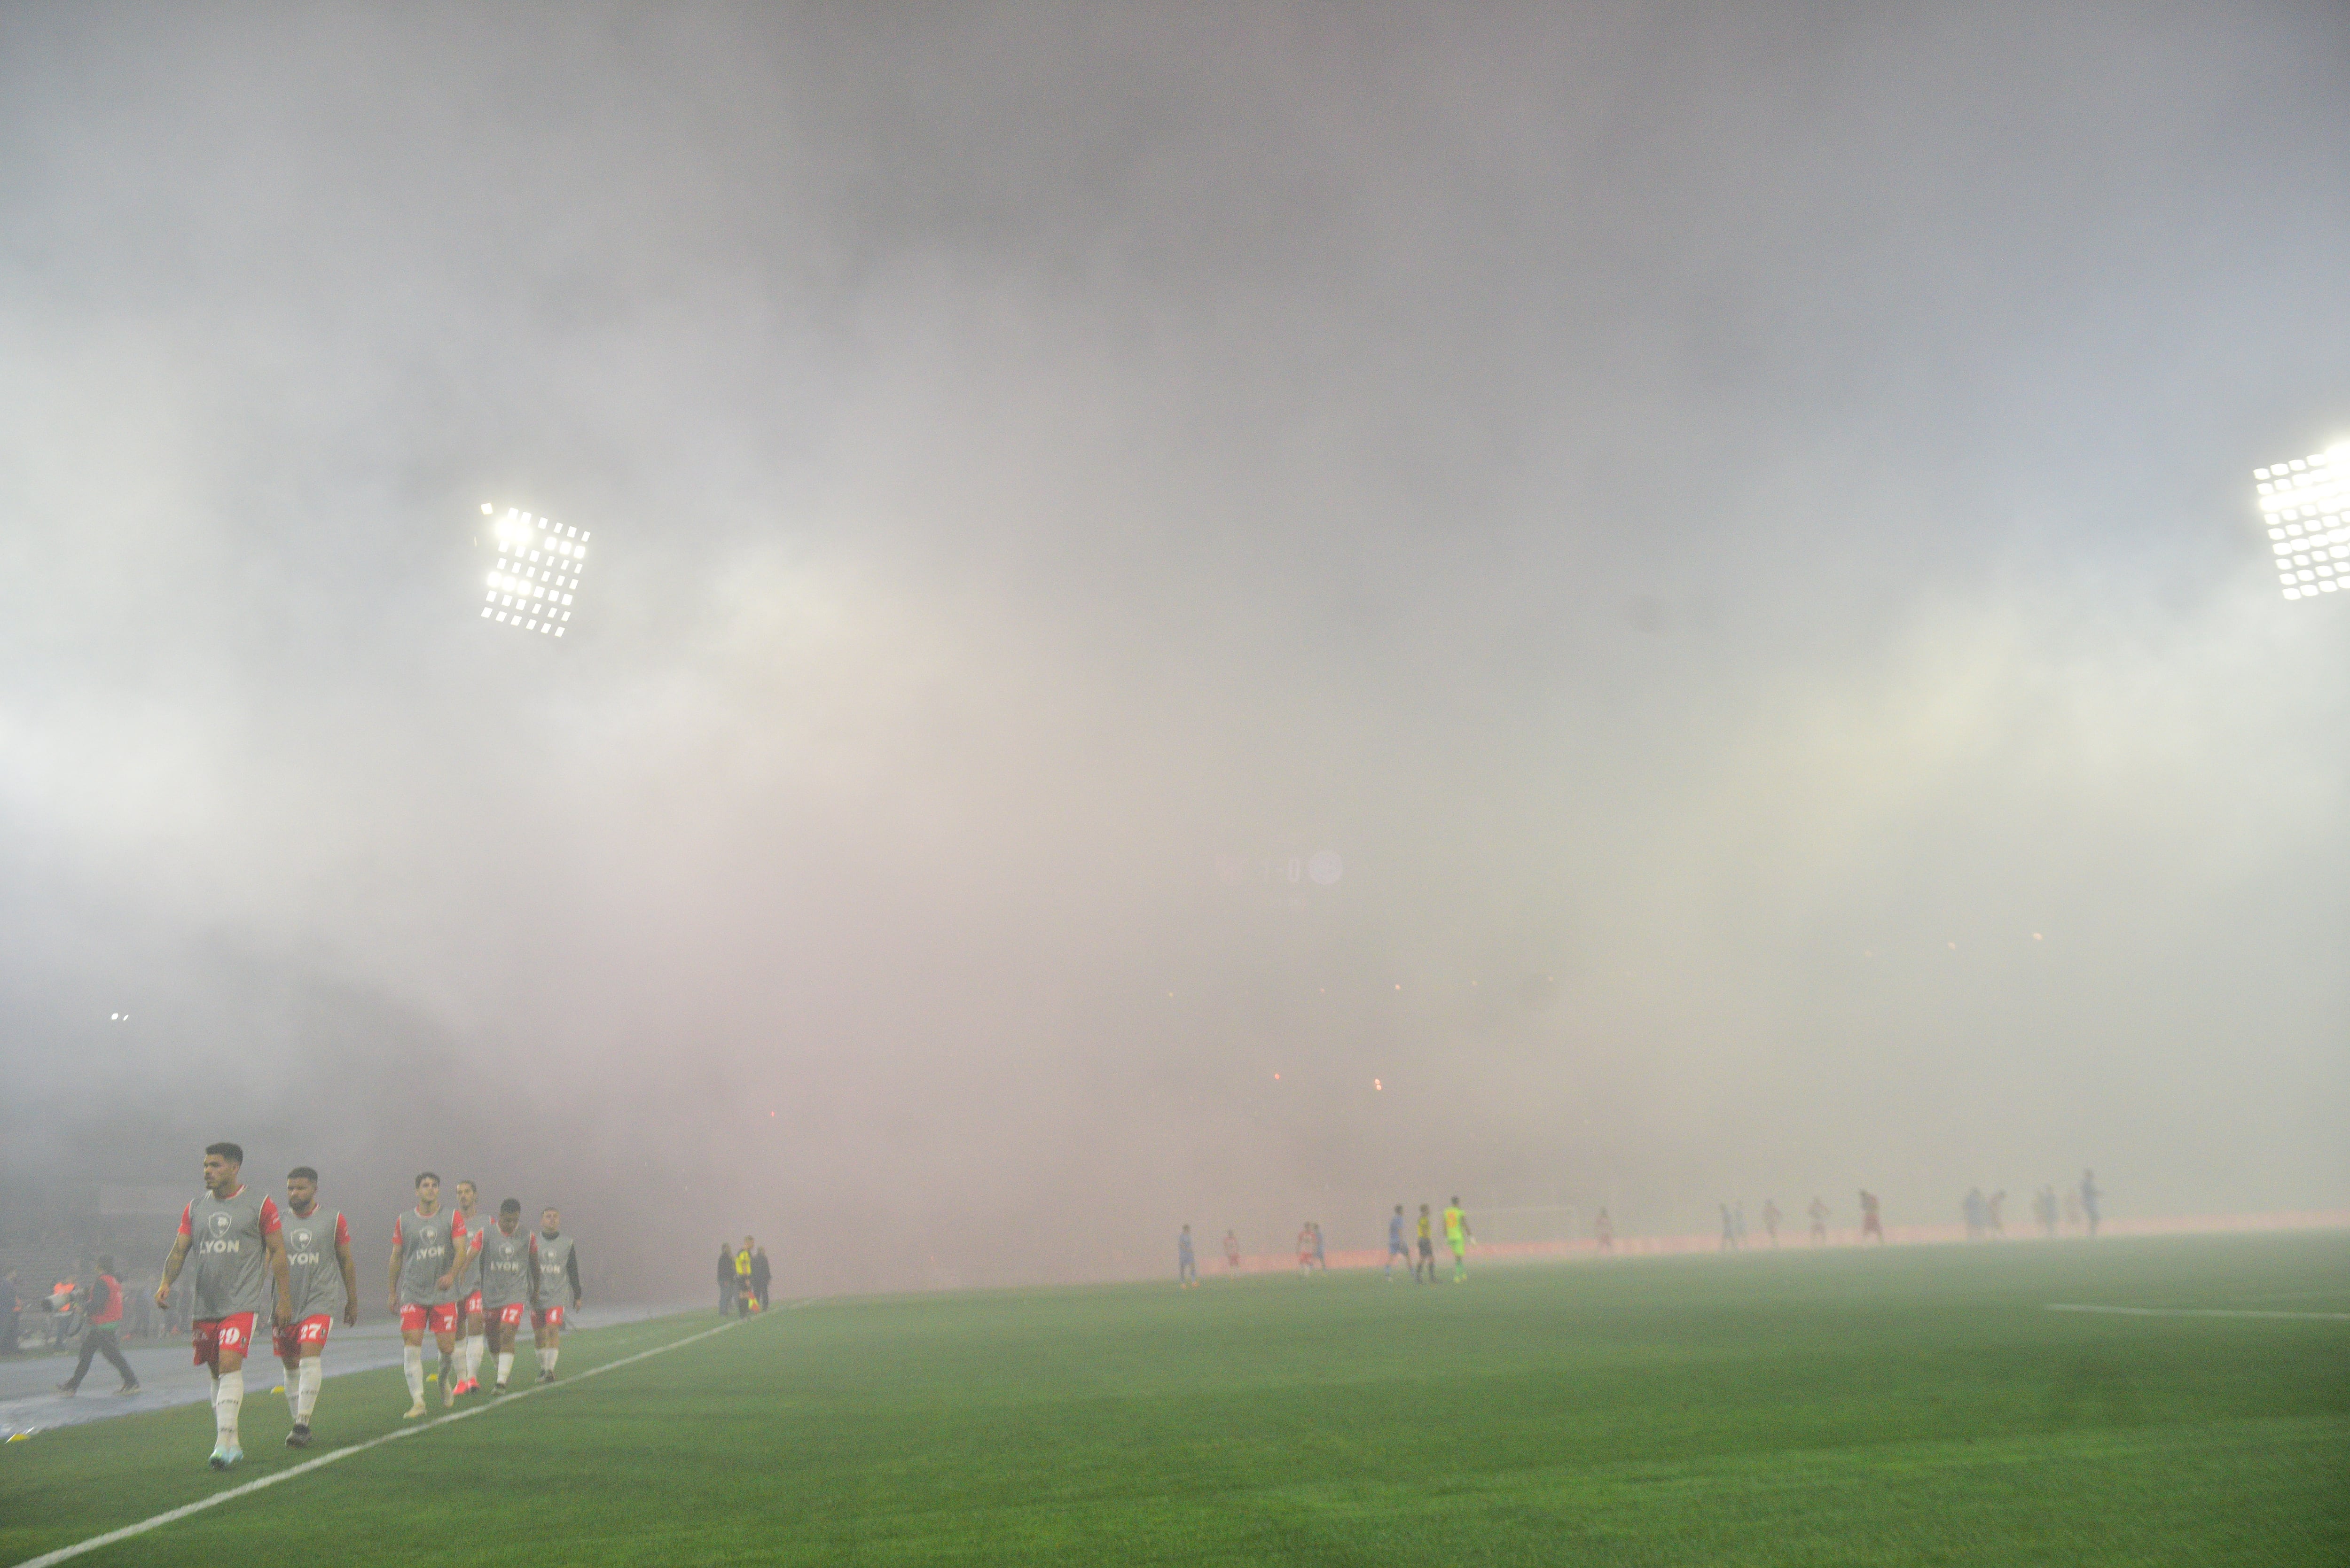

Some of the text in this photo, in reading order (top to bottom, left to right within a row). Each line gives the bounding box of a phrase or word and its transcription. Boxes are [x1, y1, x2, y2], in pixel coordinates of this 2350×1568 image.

[200, 1240, 240, 1254] LYON
[416, 1246, 445, 1260] LYON
[287, 1252, 319, 1265] YON
[540, 1264, 560, 1274] YON
[501, 1308, 518, 1321] 17
[549, 1310, 557, 1322] 4
[444, 1316, 453, 1330] 7
[300, 1323, 322, 1339] 27
